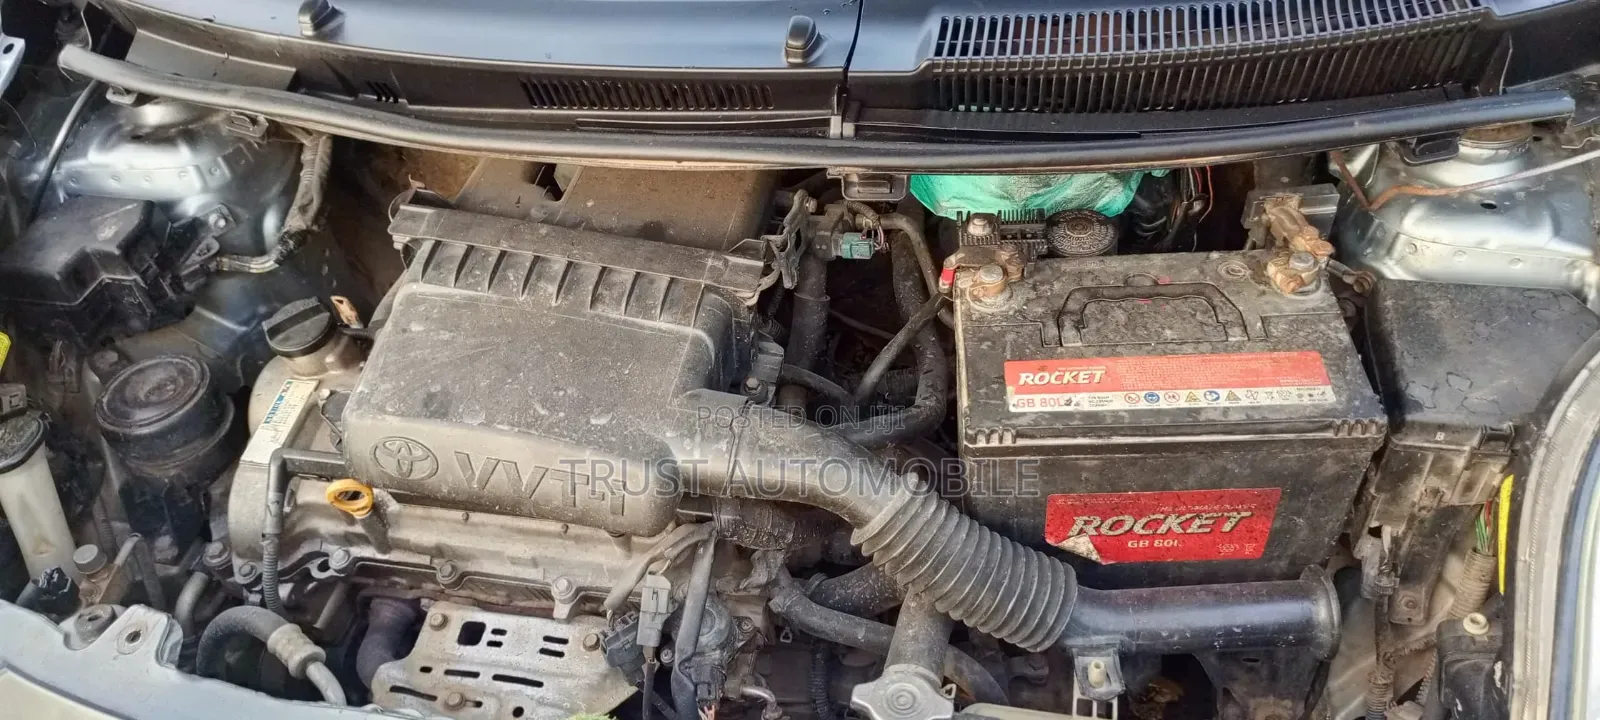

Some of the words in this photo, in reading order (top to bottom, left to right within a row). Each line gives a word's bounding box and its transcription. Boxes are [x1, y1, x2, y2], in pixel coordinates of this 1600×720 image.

[1018, 370, 1106, 386] ROCKET
[1016, 398, 1036, 408] GB
[1068, 511, 1254, 537] ROCKET
[1127, 540, 1150, 548] GB
